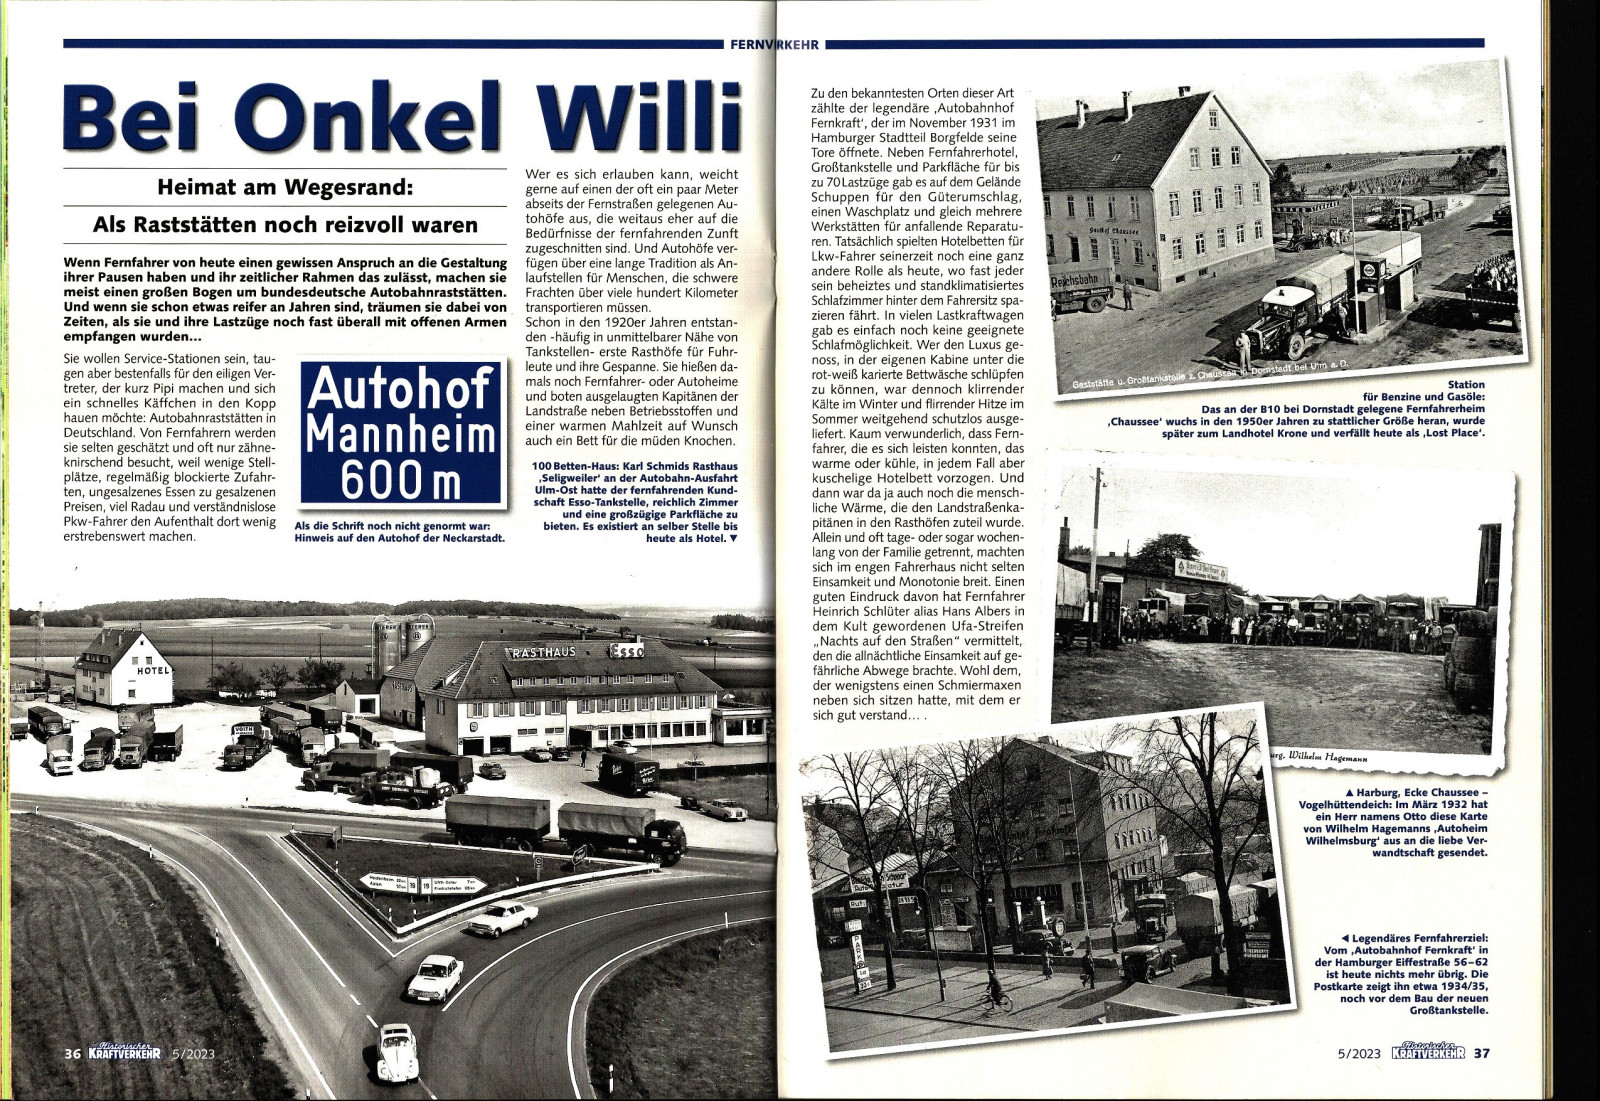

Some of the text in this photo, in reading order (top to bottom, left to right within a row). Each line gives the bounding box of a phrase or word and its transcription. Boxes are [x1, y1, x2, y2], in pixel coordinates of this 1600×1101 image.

[731, 39, 819, 50] FERNVRKEHR
[811, 88, 1014, 98] Zu den bekanntesten Orten dieser Art
[63, 79, 741, 154] Bei Onkel Willi
[525, 169, 550, 179] Wer
[574, 169, 596, 179] sich
[602, 169, 653, 179] erlauben
[660, 169, 692, 180] kann,
[699, 169, 738, 179] weicht
[159, 178, 412, 200] Heimat am Wegesrand:
[93, 215, 477, 233] Als Raststätten noch reizvoll waren
[63, 258, 100, 267] Wenn
[104, 257, 169, 267] Fernfahrer
[199, 257, 235, 267] heute
[238, 257, 272, 267] einen
[276, 257, 333, 271] gewissen
[337, 257, 394, 271] Anspruch
[398, 260, 413, 268] an
[417, 257, 437, 268] die
[441, 257, 507, 271] Gestaltung
[1050, 273, 1099, 288] Reichsbahn
[63, 287, 99, 297] meist
[103, 287, 138, 297] einen
[141, 287, 187, 300] großen
[192, 287, 232, 300] Bogen
[261, 287, 366, 297] bundesdeutsche
[369, 287, 506, 297] Autobahnraststätten.
[63, 353, 275, 365] Sie wollen Service-Stationen sein, tau-
[307, 365, 494, 409] Autohof
[1447, 380, 1485, 388] Station
[1362, 392, 1485, 401] für Benzine und Gasöle:
[1239, 405, 1257, 413] der
[1260, 405, 1280, 413] B10
[1283, 405, 1299, 413] bei
[1302, 404, 1354, 413] Dornstadt
[1356, 405, 1403, 415] gelegene
[1406, 404, 1485, 413] Fernfahrerheim
[307, 413, 495, 453] Mannheim
[342, 459, 460, 499] 600 m
[534, 486, 737, 494] Ulm-Ost hatte der fernfahrenden Kund-
[562, 510, 582, 518] und
[585, 510, 606, 518] eine
[609, 510, 666, 521] großzügige
[669, 510, 722, 518] Parkfläche
[294, 521, 310, 530] Als
[313, 521, 329, 530] die
[331, 521, 364, 530] Schrift
[367, 522, 391, 530] noch
[394, 522, 420, 530] nicht
[423, 522, 466, 532] genormt
[294, 534, 505, 542] Hinweis auf den Autohof der Neckarstadt.
[646, 534, 726, 542] heute als Hotel.
[512, 646, 576, 659] RASTHAUS
[137, 666, 170, 676] HOTEL
[1289, 750, 1322, 761] Wilhelm
[1325, 752, 1368, 763] Hagemann
[1298, 800, 1392, 811] Vogelhüttendeich:
[1411, 800, 1437, 808] März
[1441, 800, 1467, 808] 1932
[1471, 800, 1488, 808] hat
[1315, 813, 1331, 821] ein
[1334, 813, 1357, 821] Herr
[1429, 812, 1456, 820] diese
[1460, 812, 1488, 820] Karte
[423, 882, 430, 890] 19
[1352, 933, 1488, 945] Legendäres Fernfahrerziel:
[1326, 970, 1488, 980] ist heute nichts mehr übrig. Die
[1340, 994, 1365, 1003] noch
[1388, 994, 1410, 1002] dem
[1414, 994, 1433, 1002] Bau
[1436, 994, 1454, 1002] der
[1338, 1048, 1381, 1060] 5/2023
[1391, 1046, 1466, 1060] KRAFTVERKEHR
[1473, 1048, 1491, 1059] 37
